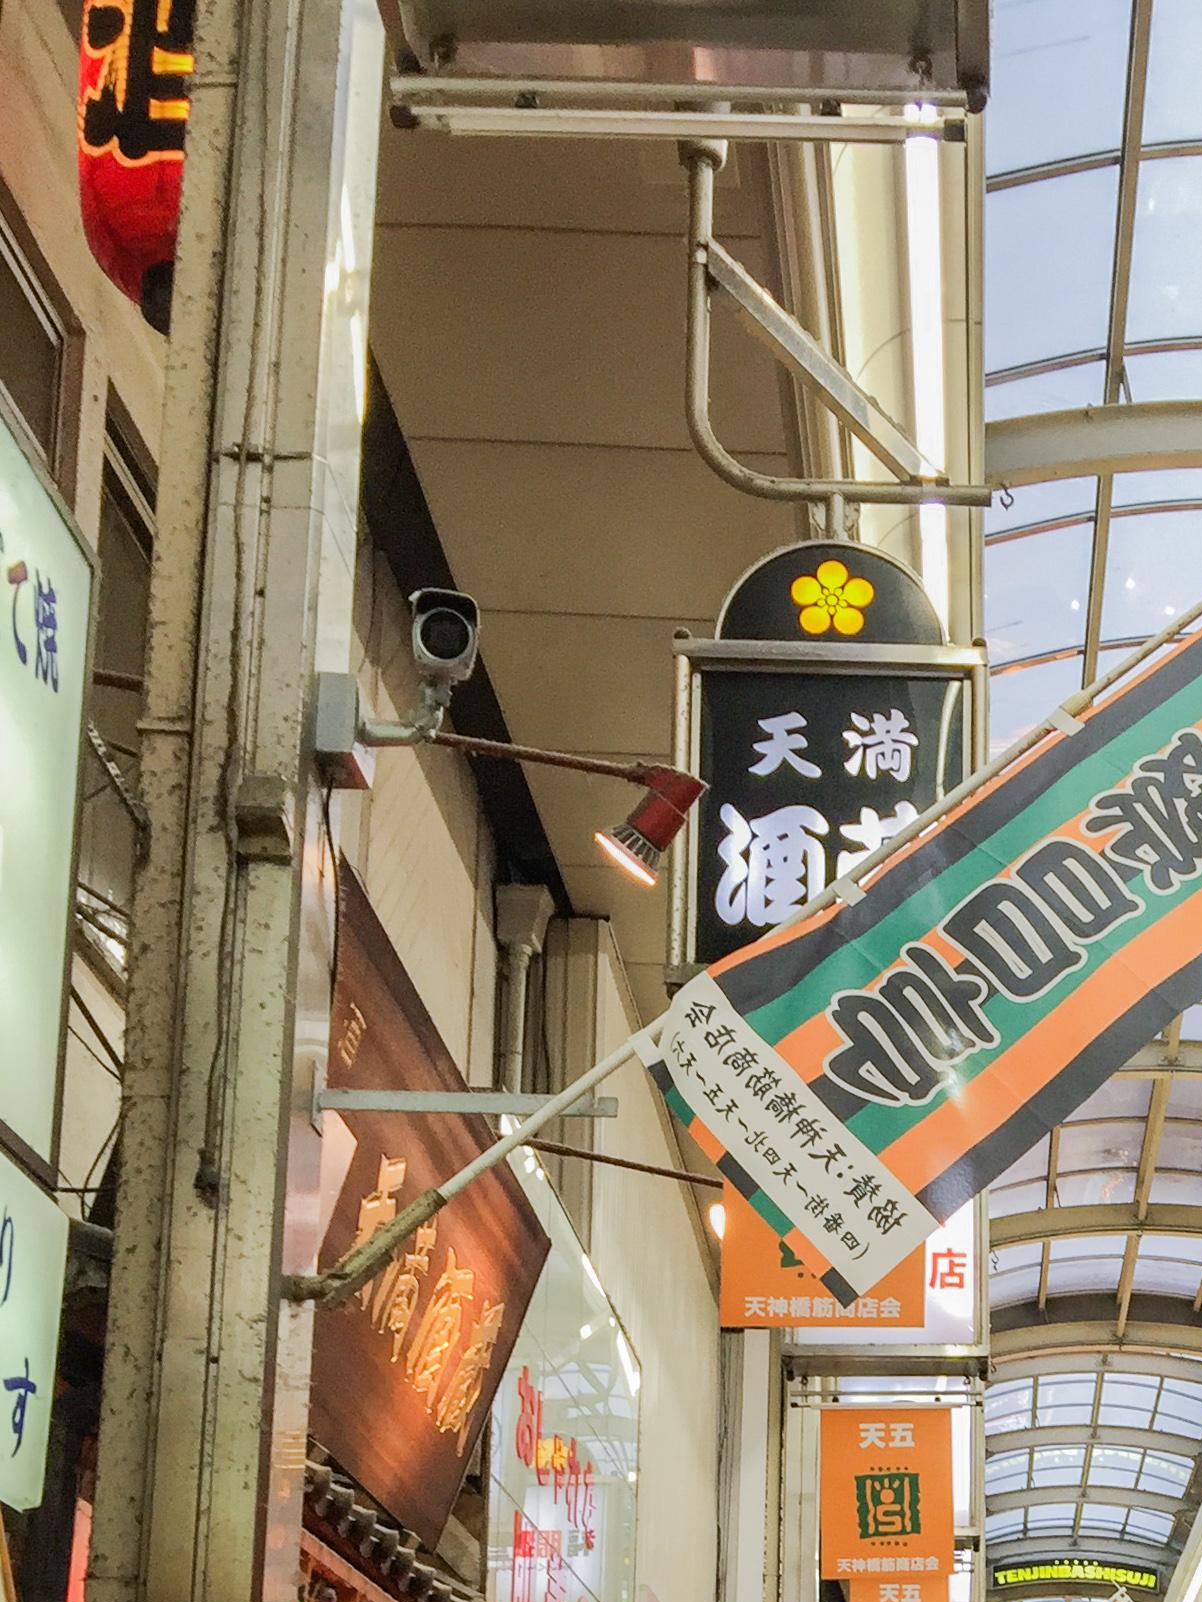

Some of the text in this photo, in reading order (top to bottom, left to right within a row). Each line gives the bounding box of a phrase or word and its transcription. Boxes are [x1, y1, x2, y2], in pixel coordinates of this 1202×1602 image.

[748, 710, 919, 783] 天満
[930, 1247, 967, 1290] 店
[859, 1423, 915, 1449] 天五
[995, 1565, 1157, 1588] TENJINBASHISUJI
